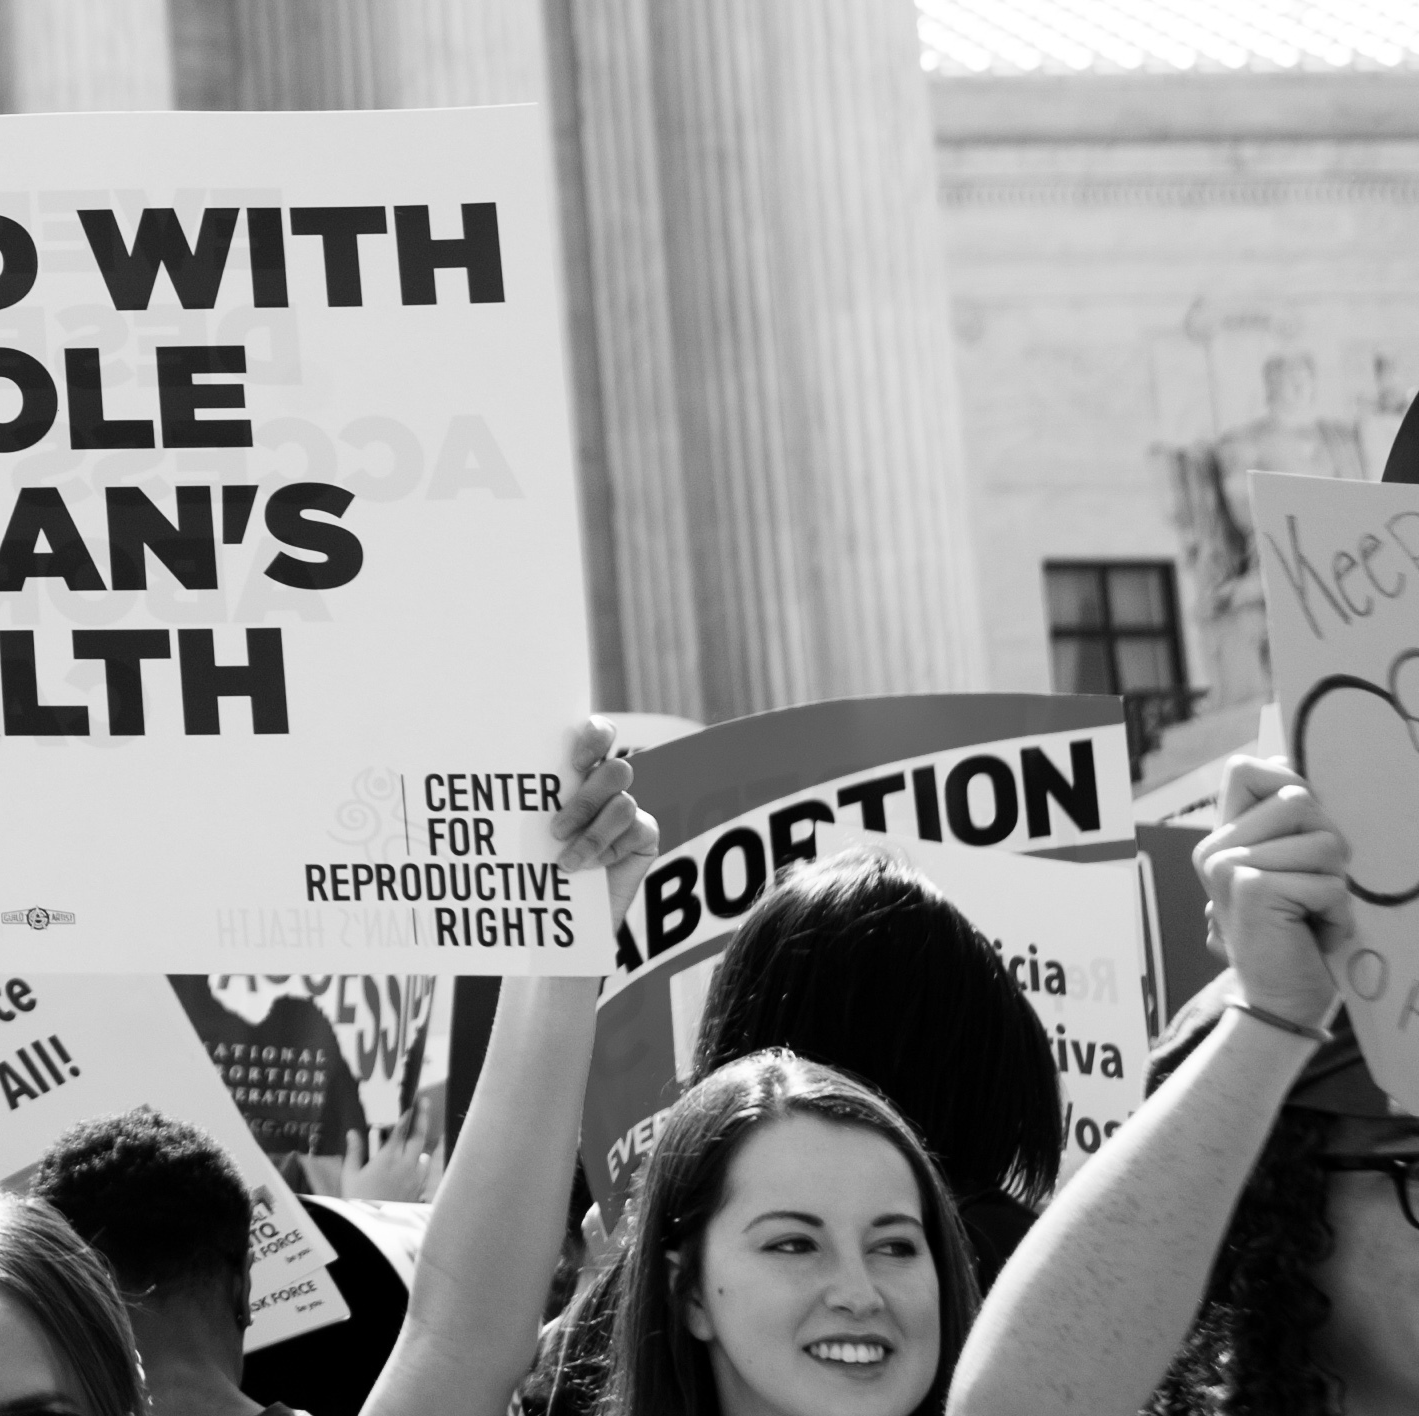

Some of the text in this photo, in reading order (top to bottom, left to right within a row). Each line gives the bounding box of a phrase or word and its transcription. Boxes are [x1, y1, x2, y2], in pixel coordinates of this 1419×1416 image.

[77, 202, 505, 311] WITH
[424, 773, 563, 813] CENTER
[427, 817, 498, 856] FOR
[305, 862, 572, 902] REPRODUCTIVE
[435, 907, 575, 948] RIGHTS
[203, 1041, 326, 1066] ATIONAL
[216, 1063, 326, 1087] ORTION
[229, 1086, 326, 1107] ERATION
